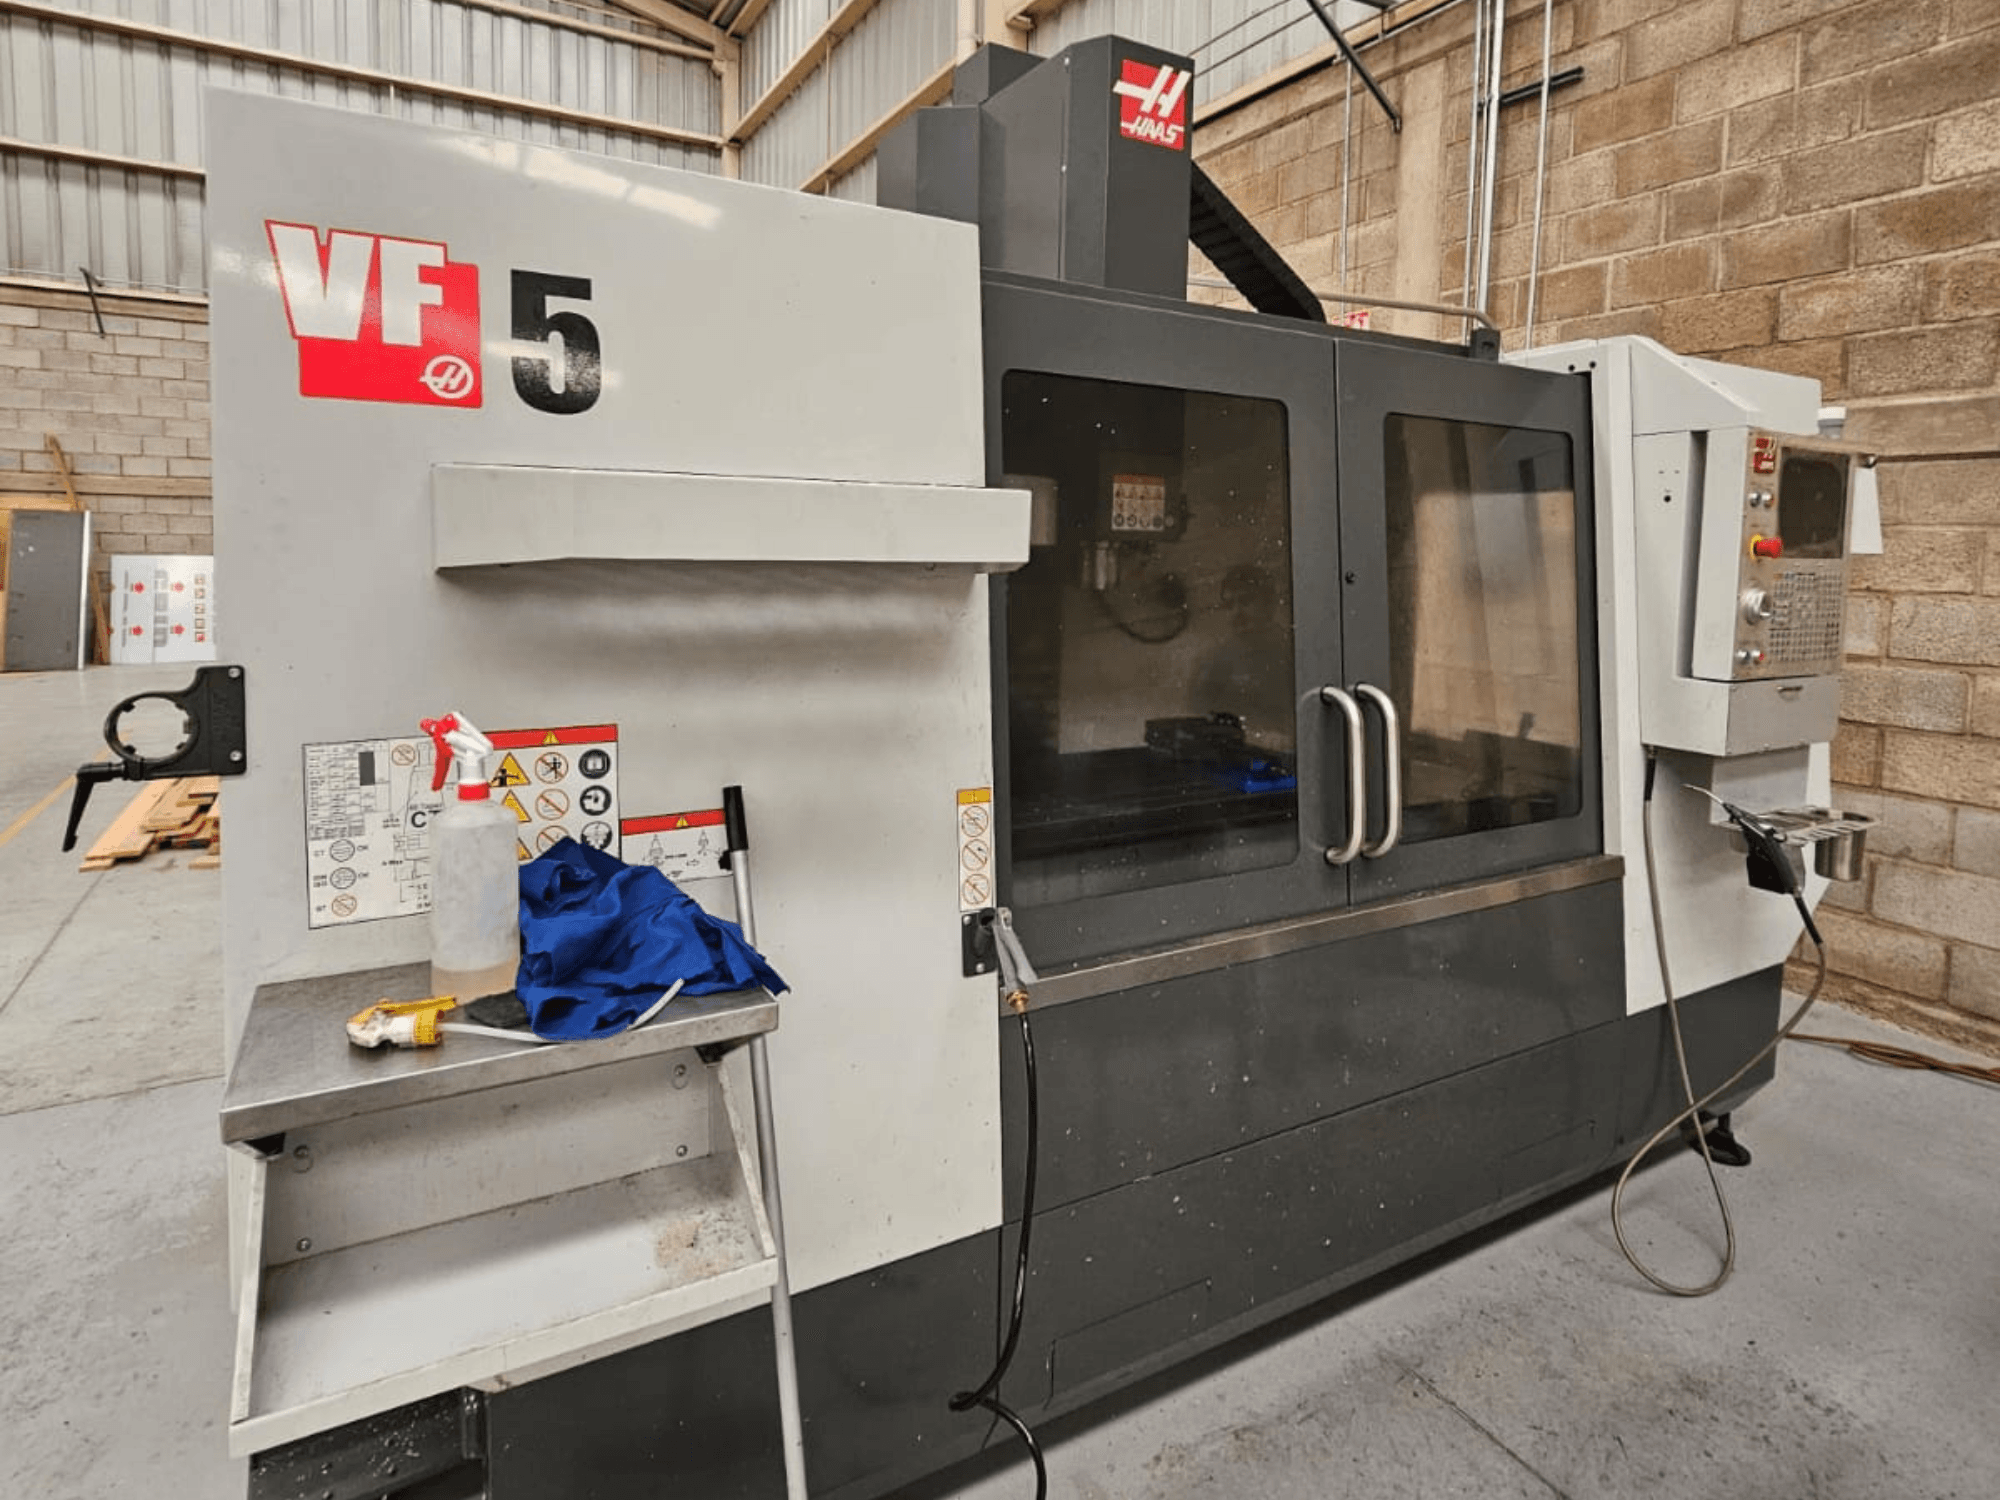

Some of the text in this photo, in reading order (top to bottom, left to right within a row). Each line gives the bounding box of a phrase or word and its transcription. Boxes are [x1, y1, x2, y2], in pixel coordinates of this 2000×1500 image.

[1121, 115, 1184, 144] HAAS
[267, 223, 602, 416] VF 5
